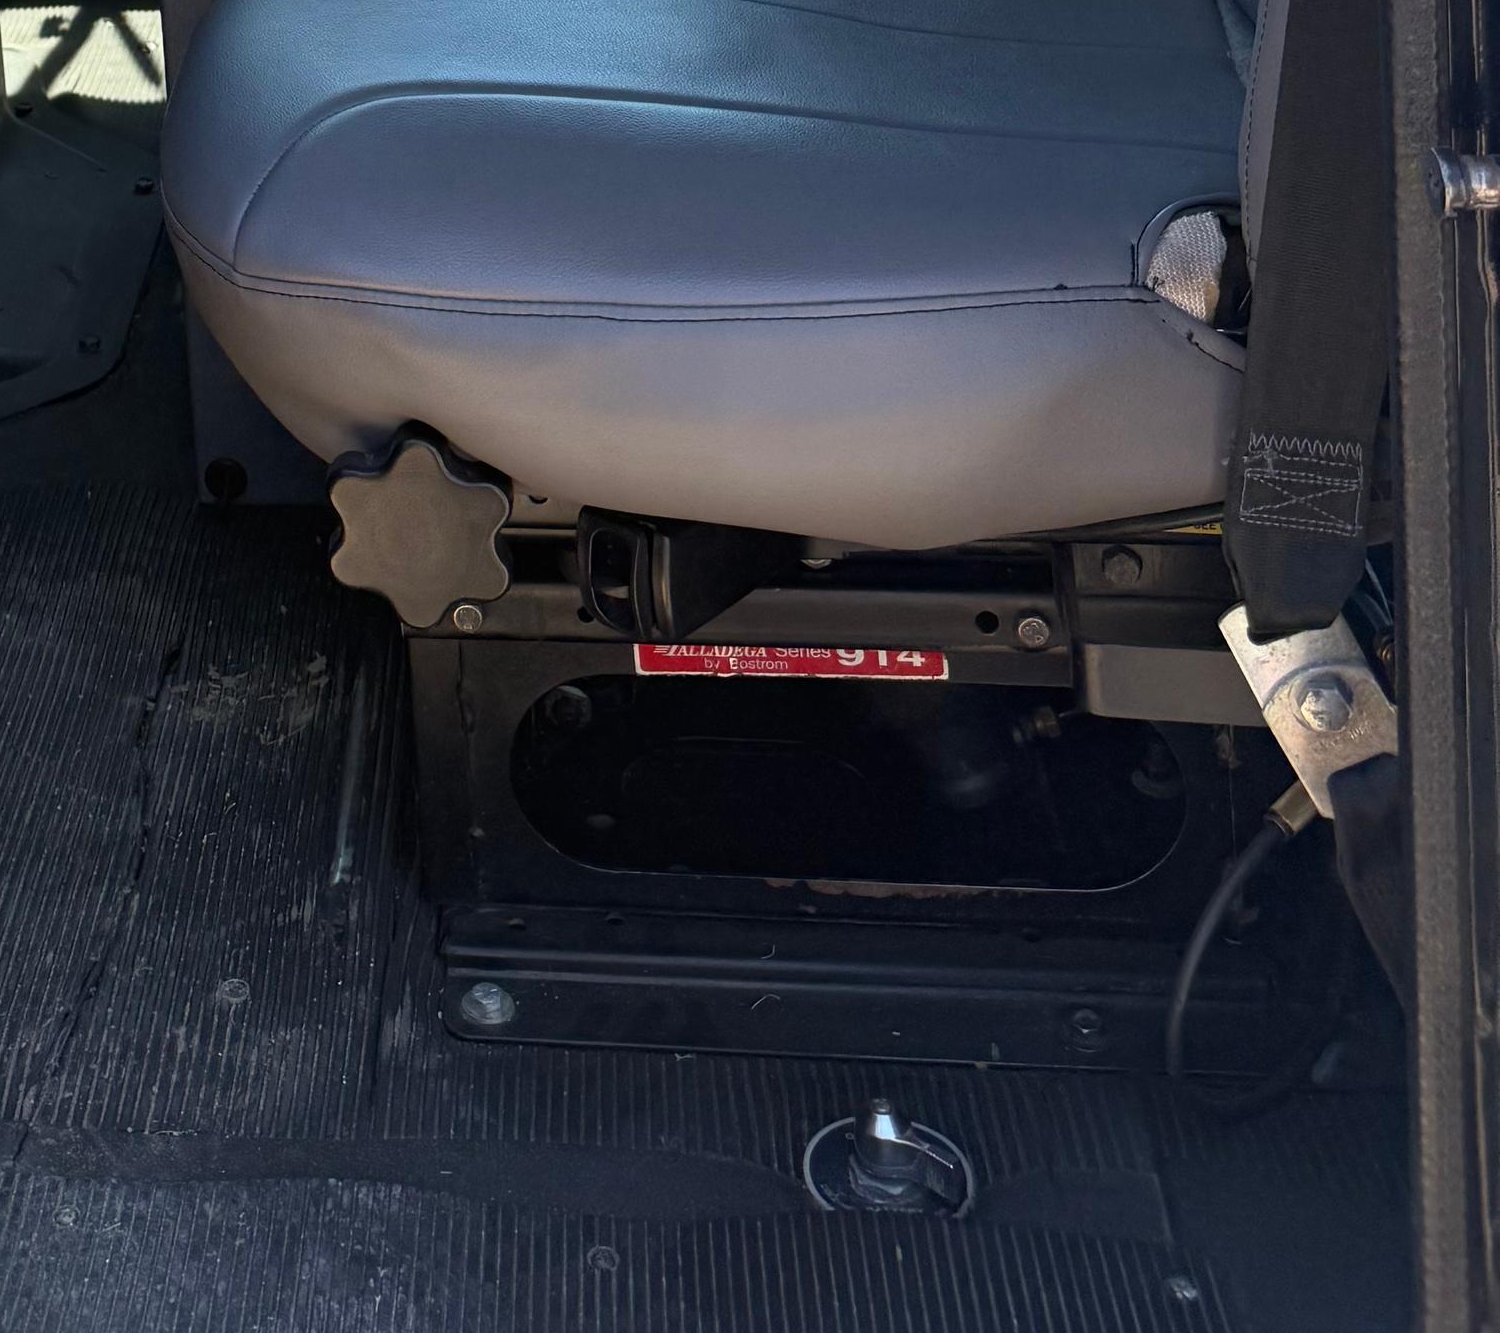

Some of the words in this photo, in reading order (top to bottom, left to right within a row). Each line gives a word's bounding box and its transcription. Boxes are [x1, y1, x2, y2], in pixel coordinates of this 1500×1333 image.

[774, 647, 832, 658] Series
[704, 657, 720, 671] by
[729, 657, 789, 671] Bostrom
